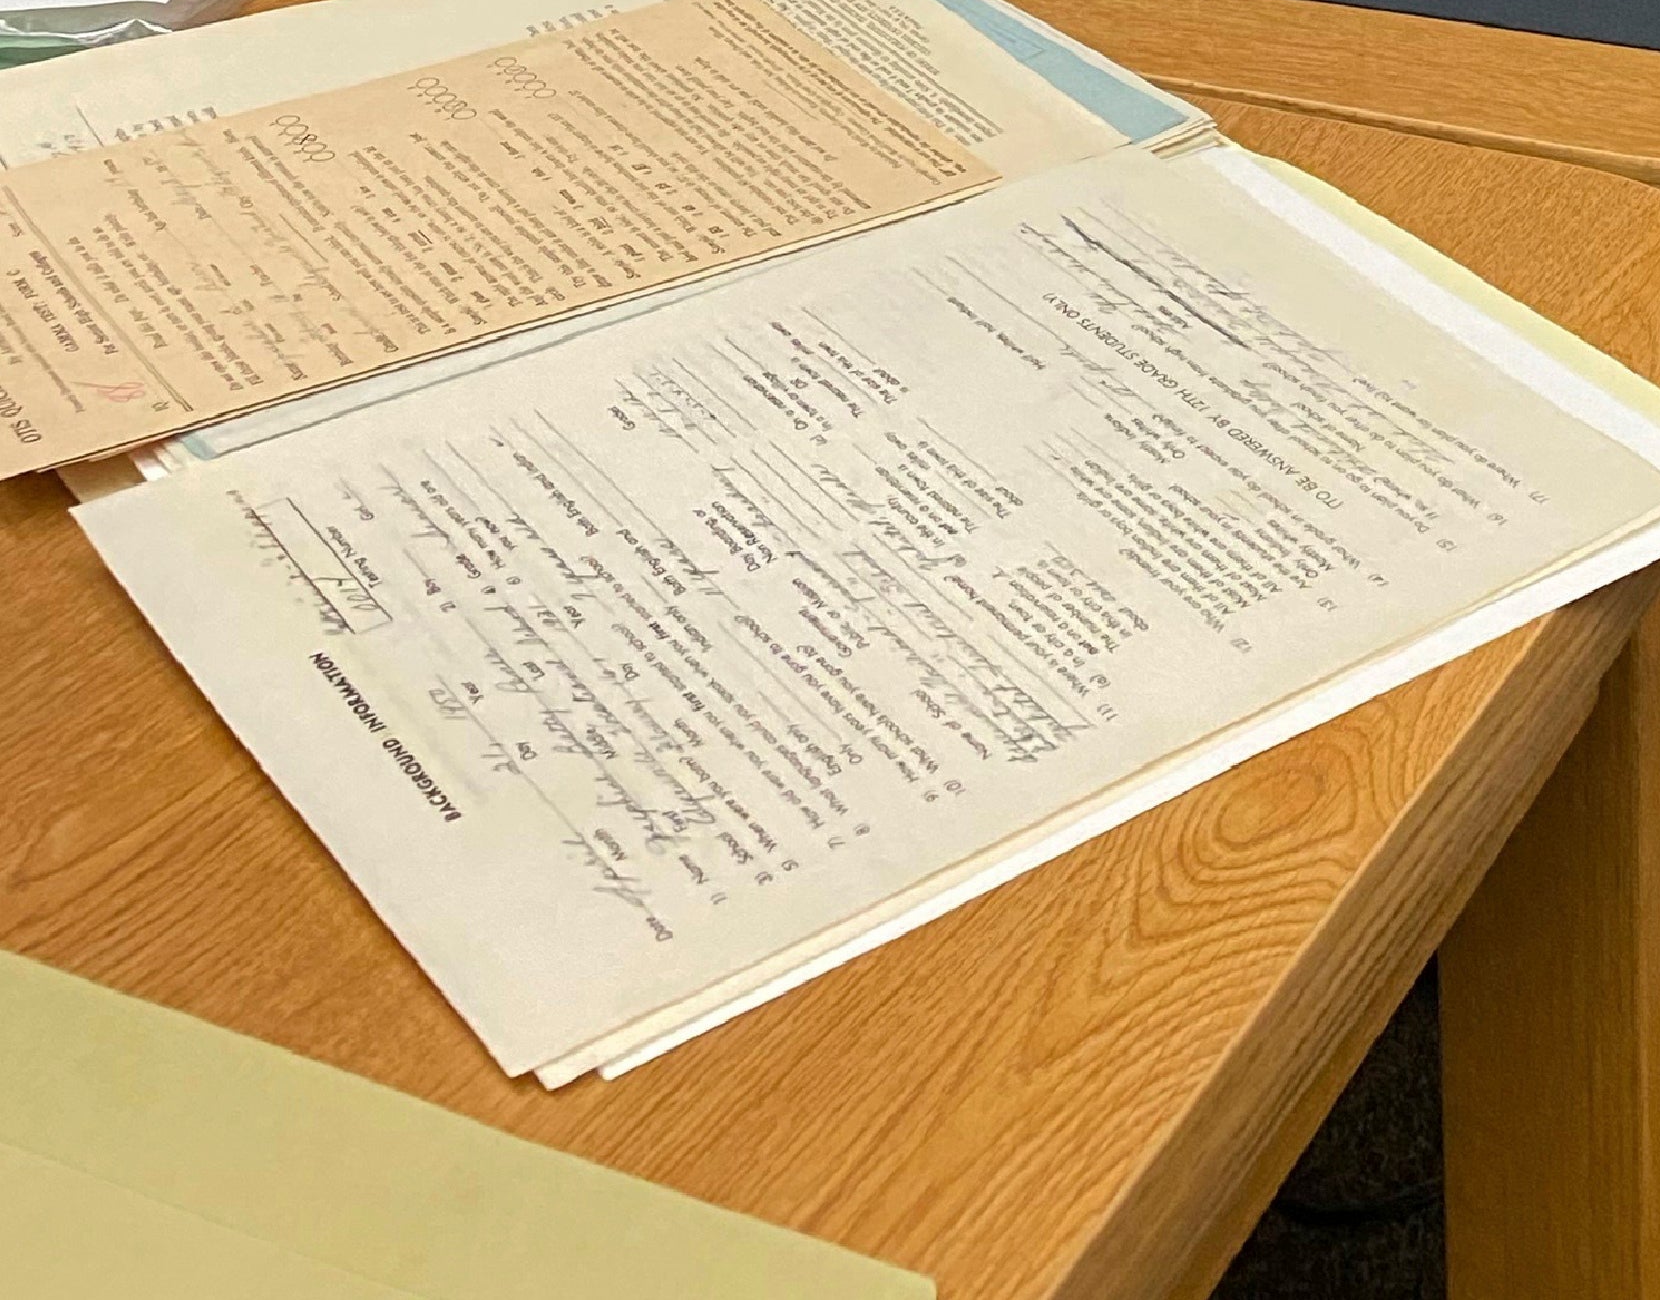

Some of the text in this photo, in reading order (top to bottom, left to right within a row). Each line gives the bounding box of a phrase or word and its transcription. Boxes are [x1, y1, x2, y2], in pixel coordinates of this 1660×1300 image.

[1074, 316, 1142, 360] STUDENTS
[1131, 357, 1182, 390] GRADE
[1171, 387, 1213, 413] 12TH
[16, 418, 43, 444] OTIS
[1224, 426, 1301, 477] ANSWERED
[307, 649, 465, 823] BACKGROUND INFORMATION
